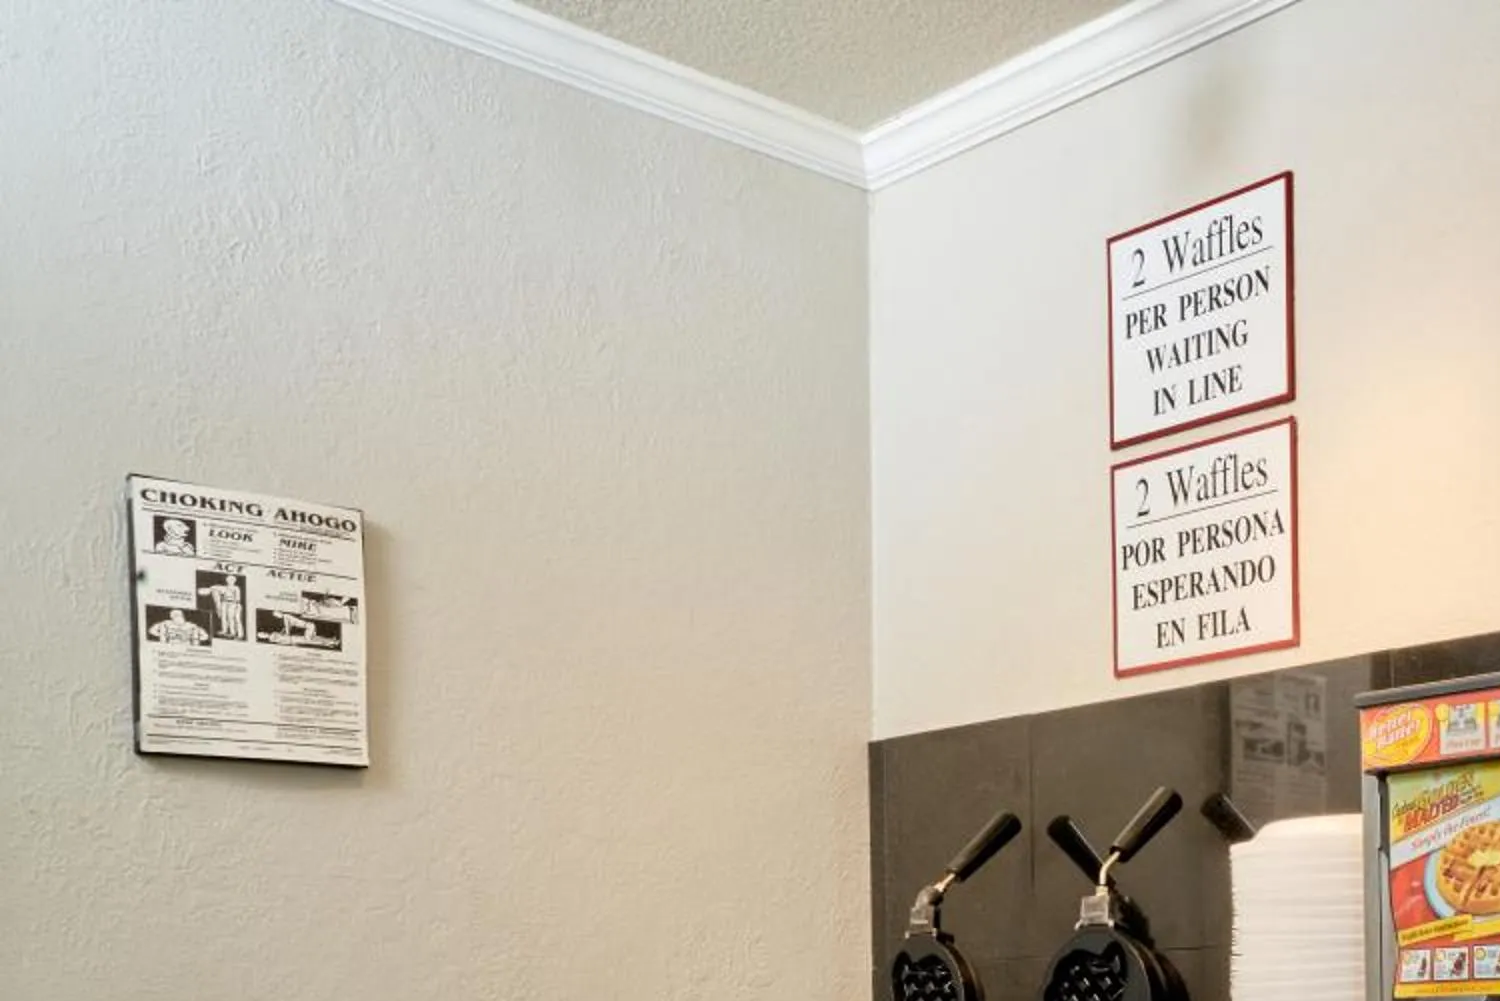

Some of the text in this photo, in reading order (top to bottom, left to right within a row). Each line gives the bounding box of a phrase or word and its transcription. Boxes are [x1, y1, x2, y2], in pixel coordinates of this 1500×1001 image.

[1131, 214, 1264, 289] 2 Waffles
[1125, 265, 1271, 340] PER PERSON
[1146, 319, 1249, 375] WAITING
[1153, 364, 1244, 416] IN LINE
[140, 487, 264, 518] CHOKING
[274, 507, 357, 533] AHOGO
[1136, 453, 1268, 518] 2 Waffles
[208, 527, 254, 543] LOOK
[1121, 507, 1285, 571] POR PERSONA
[213, 562, 245, 574] ACT
[266, 568, 317, 584] ACTUE
[1132, 554, 1276, 611] ESPERANDO
[1156, 606, 1251, 649] EN FILA
